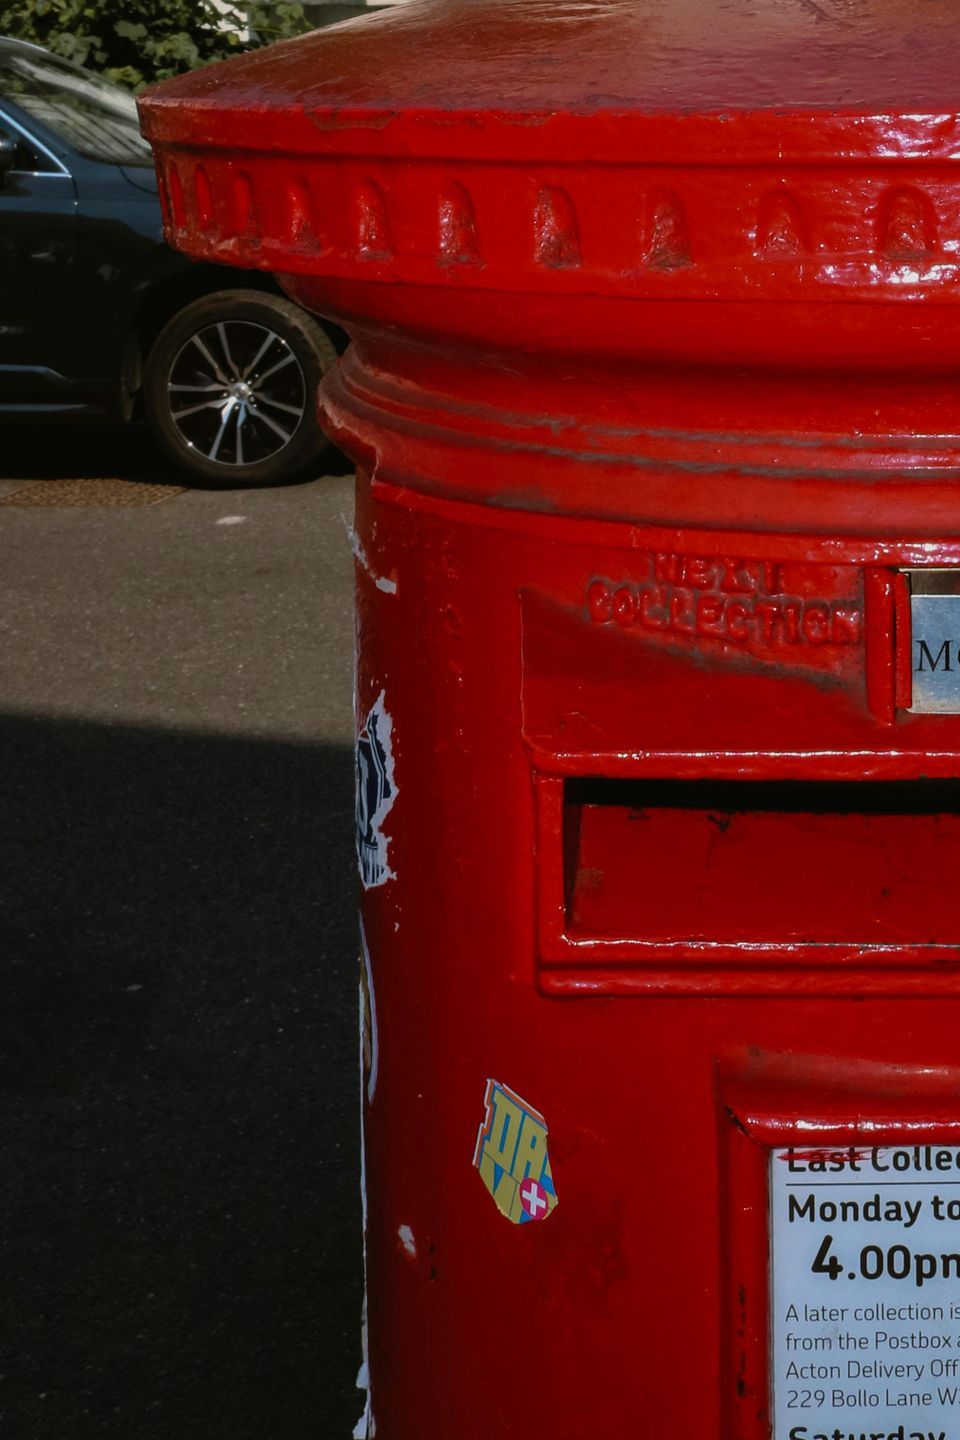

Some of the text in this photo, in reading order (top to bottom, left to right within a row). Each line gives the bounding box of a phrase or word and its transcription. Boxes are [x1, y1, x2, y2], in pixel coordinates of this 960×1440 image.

[653, 551, 782, 594] NEXT
[587, 581, 860, 644] COLLECTION
[788, 1147, 862, 1173] Last
[788, 1193, 922, 1228] Monday
[786, 1304, 799, 1322] A
[804, 1304, 849, 1322] later
[854, 1303, 944, 1321] collection
[786, 1332, 832, 1350] from
[838, 1332, 869, 1350] the
[875, 1331, 952, 1349] Postbox
[786, 1361, 841, 1380] Acton
[847, 1360, 925, 1381] Delivery
[787, 1389, 826, 1408] 229
[832, 1389, 880, 1408] Bollo
[886, 1388, 933, 1407] Lane
